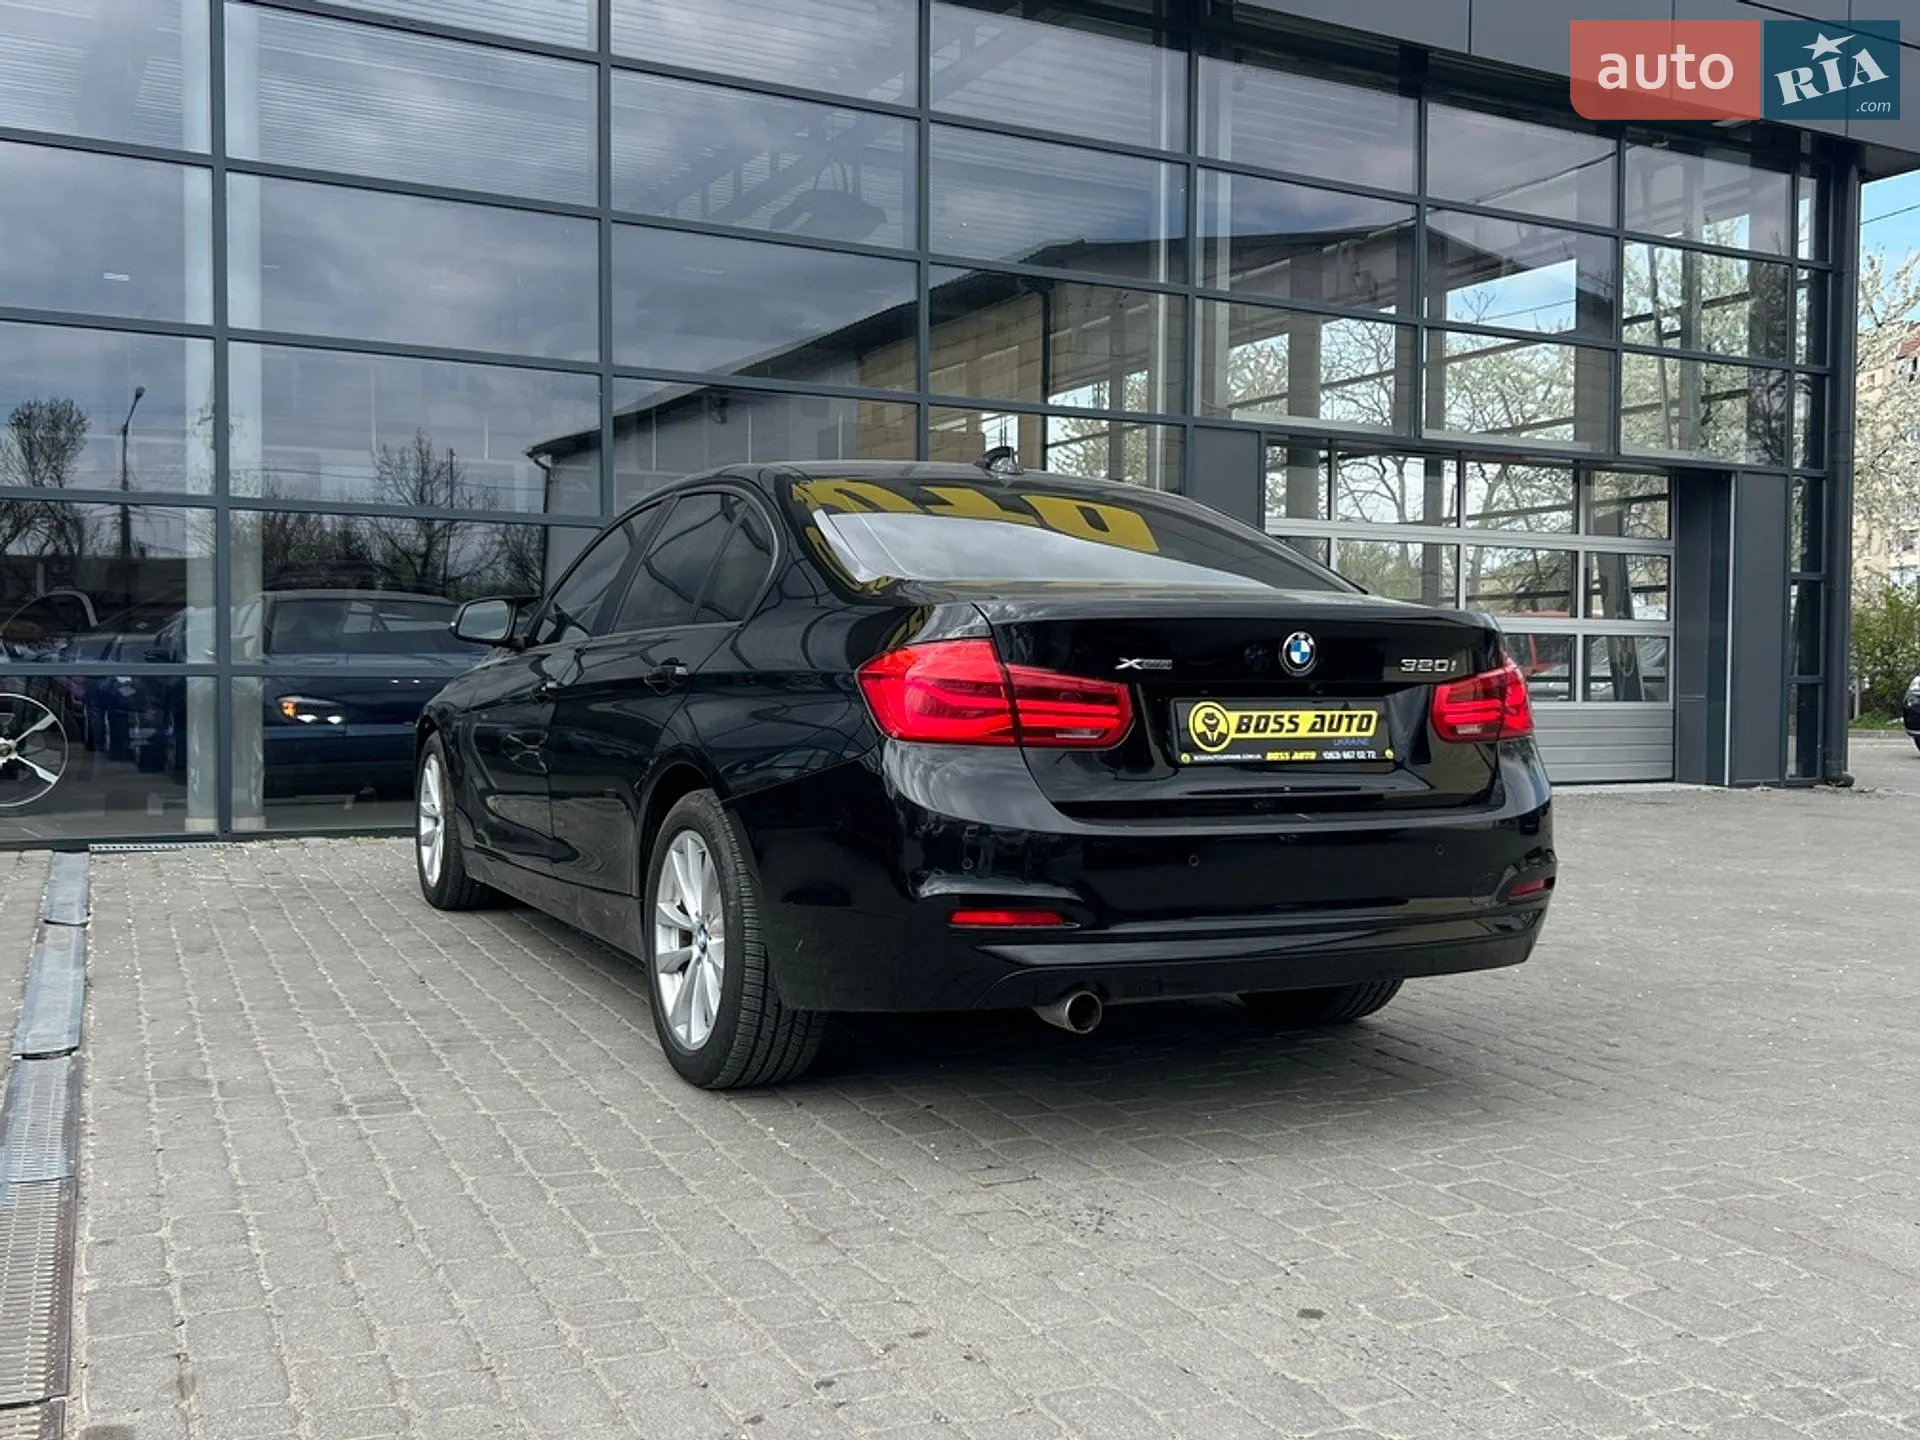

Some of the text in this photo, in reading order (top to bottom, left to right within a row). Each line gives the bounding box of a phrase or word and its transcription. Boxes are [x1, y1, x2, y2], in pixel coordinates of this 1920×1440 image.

[1401, 659, 1457, 672] 320i
[1235, 713, 1372, 734] BOSS AUTO
[1266, 752, 1290, 761] BOSS
[1292, 751, 1316, 760] AUTO
